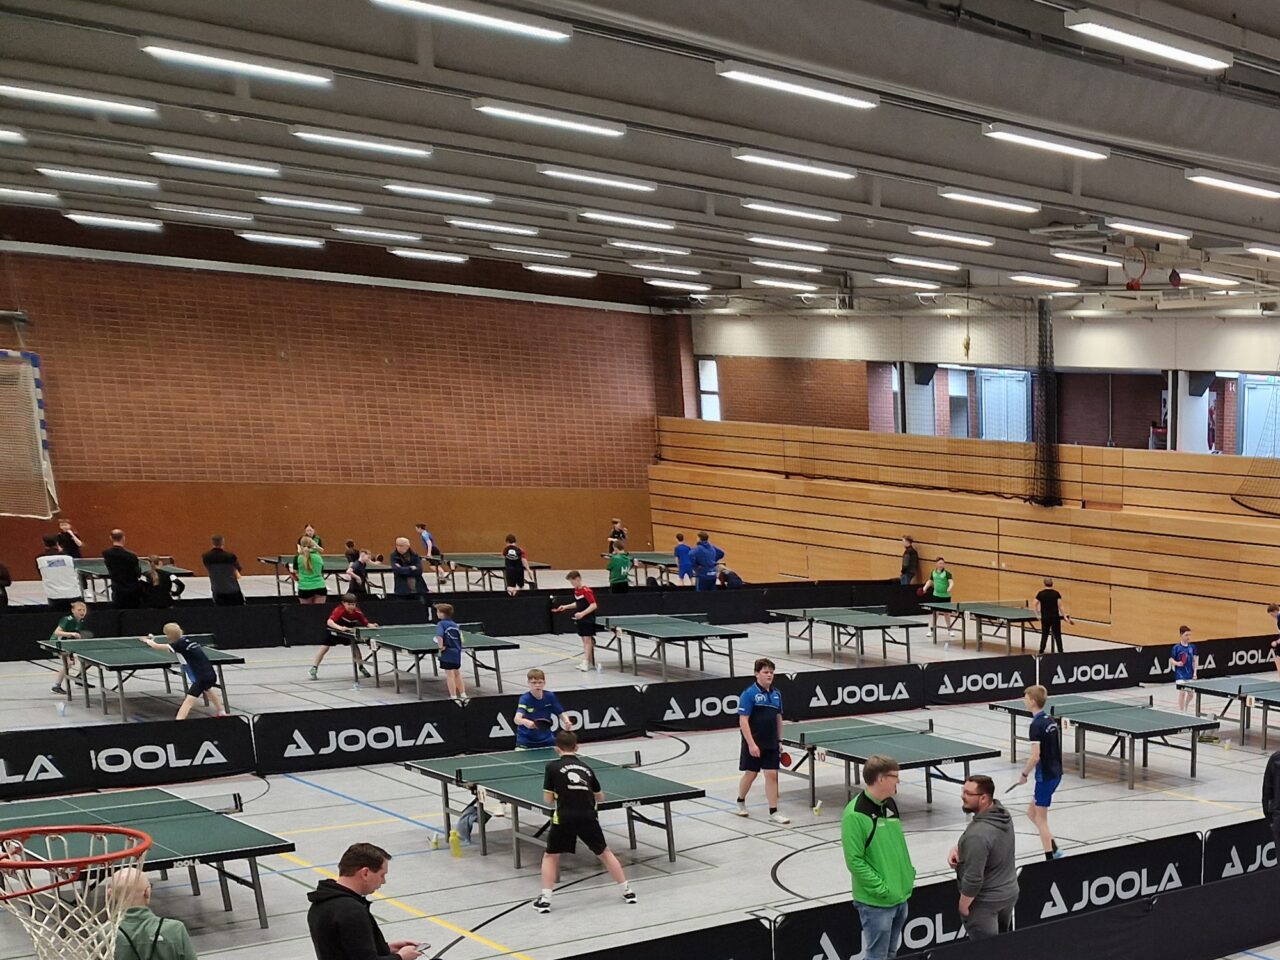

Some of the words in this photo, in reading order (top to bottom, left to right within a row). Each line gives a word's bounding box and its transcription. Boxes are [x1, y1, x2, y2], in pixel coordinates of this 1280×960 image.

[1228, 648, 1277, 667] JOOLA
[957, 671, 1025, 692] JOOLA
[1068, 662, 1129, 683] JOOLA
[830, 681, 910, 706] JOOLA
[318, 722, 445, 755] JOOLA
[1071, 862, 1183, 913] JOOLA
